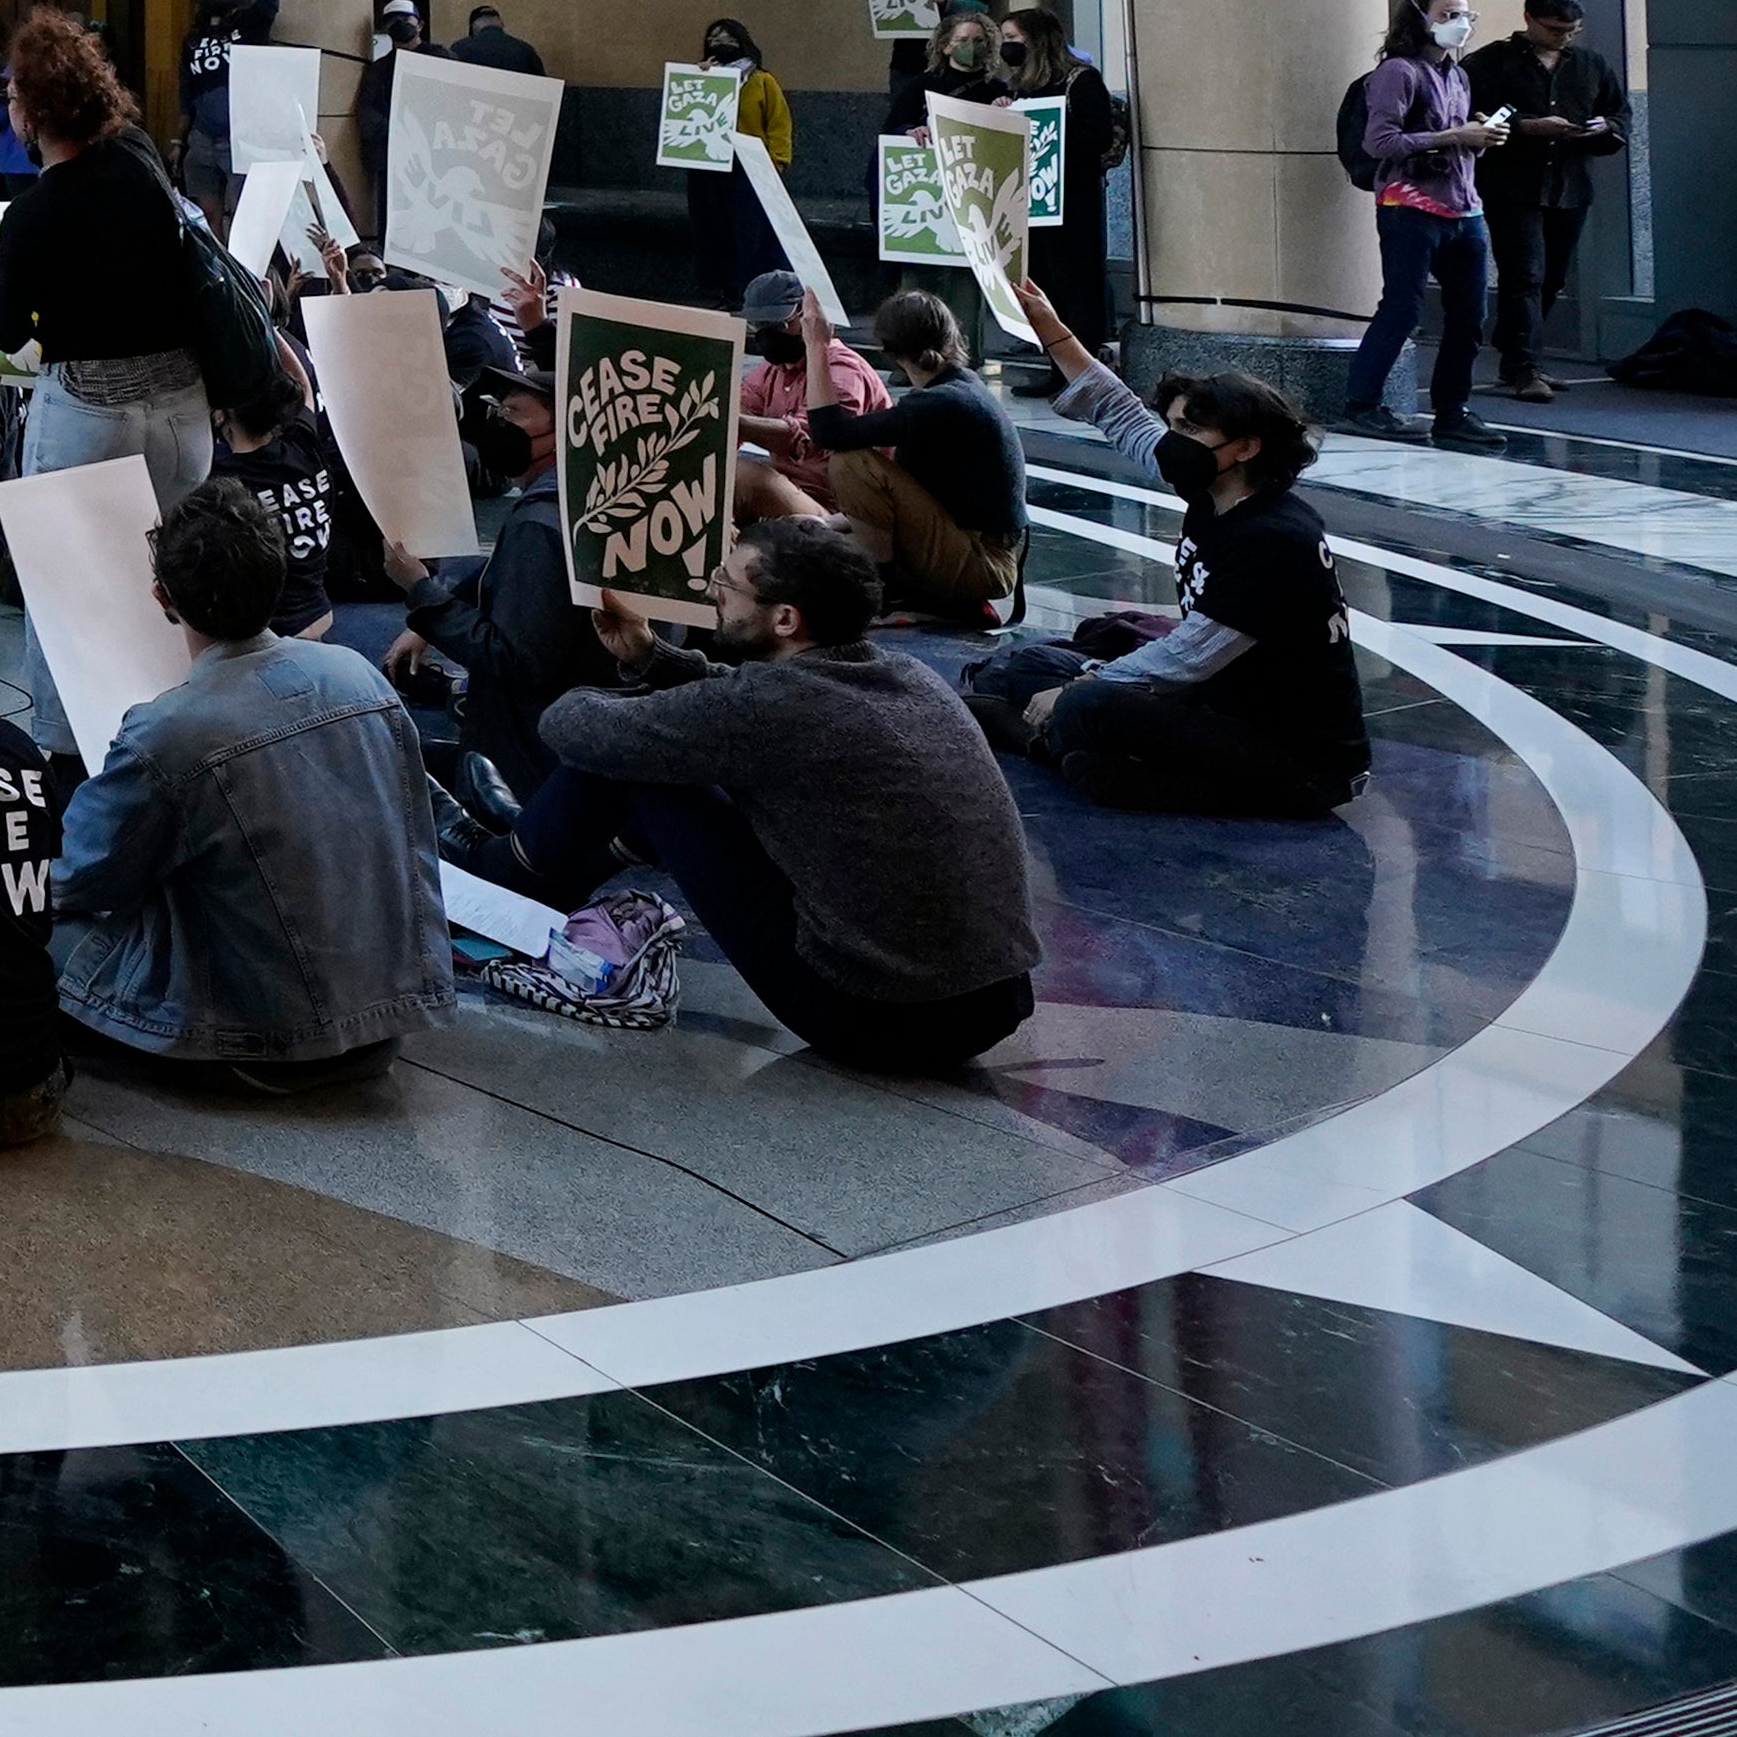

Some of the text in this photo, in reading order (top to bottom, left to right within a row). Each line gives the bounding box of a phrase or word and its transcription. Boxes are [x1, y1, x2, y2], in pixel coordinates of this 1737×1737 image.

[668, 91, 719, 113] GAZA
[671, 78, 706, 94] LET
[678, 111, 729, 137] LIVE
[885, 153, 926, 174] LET
[940, 134, 975, 166] LET
[945, 163, 995, 209] GAZA
[567, 348, 682, 449] CEASE
[590, 393, 664, 457] FIRE
[257, 468, 331, 513] EASE
[601, 451, 717, 593] NOW!
